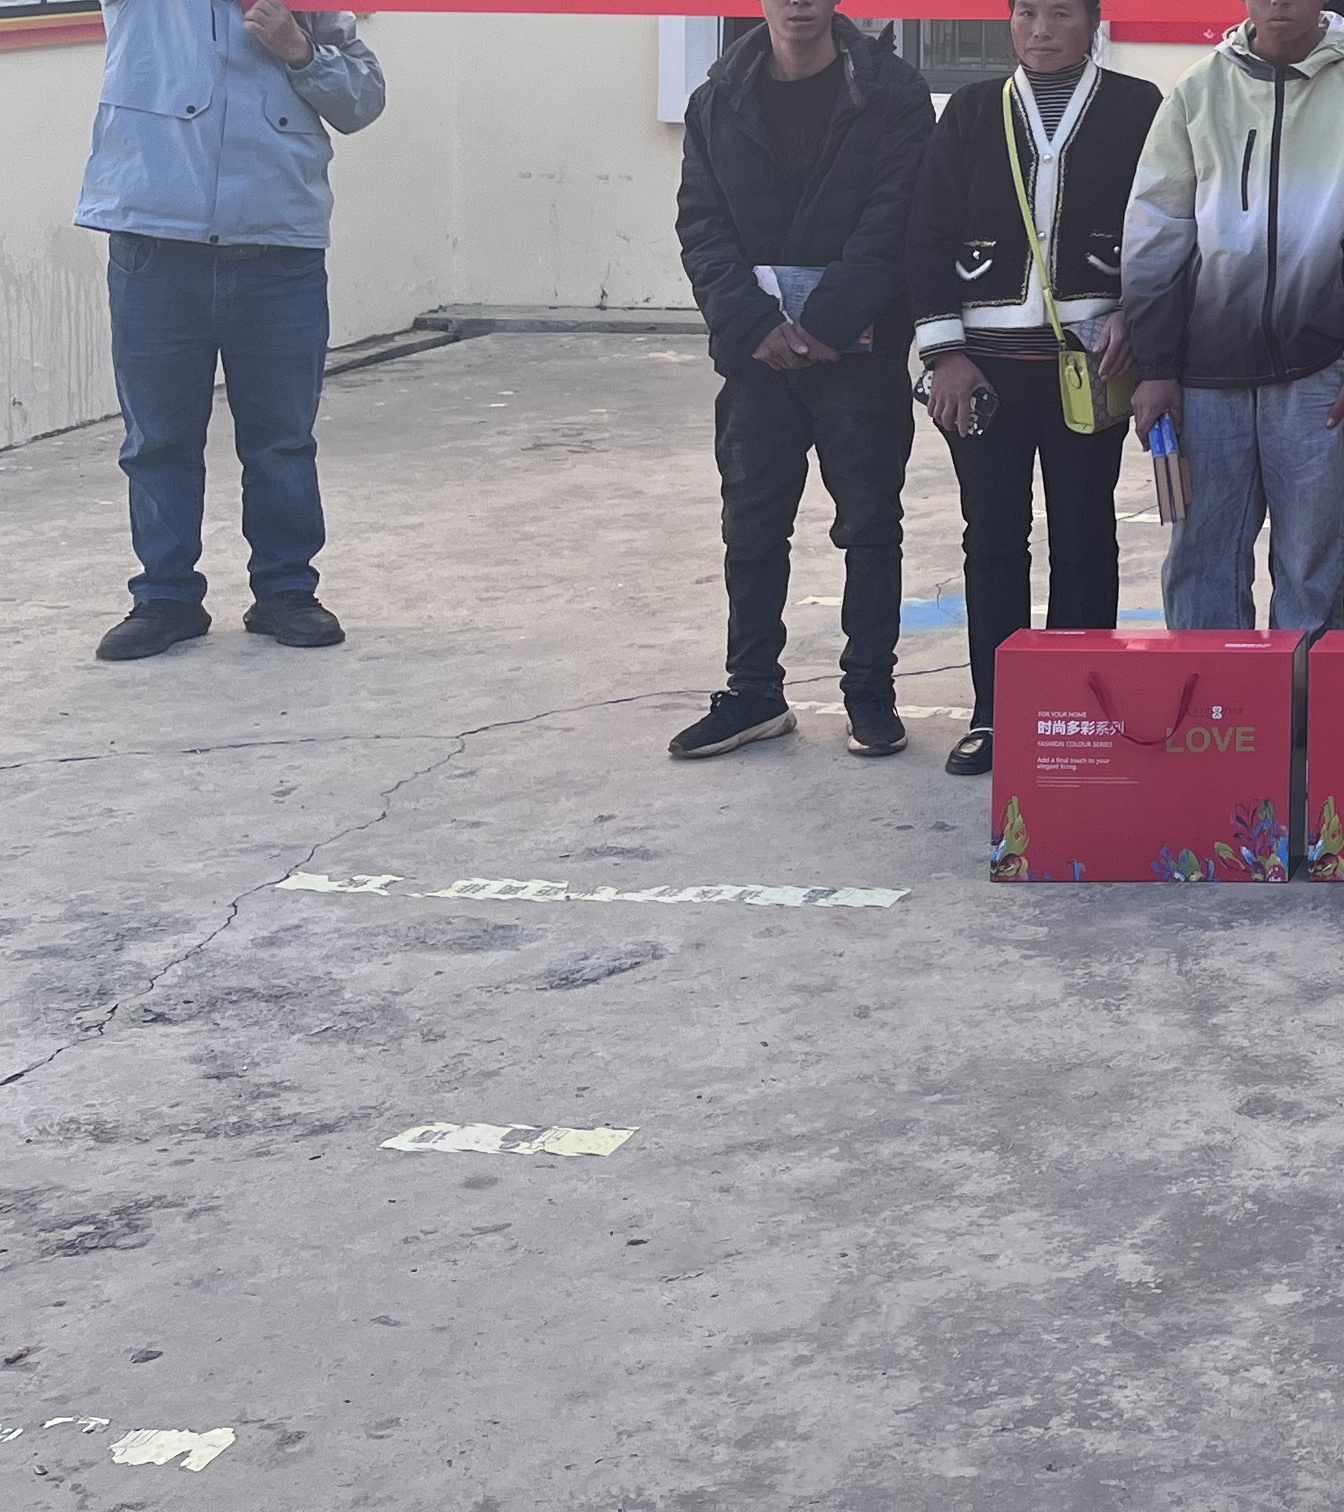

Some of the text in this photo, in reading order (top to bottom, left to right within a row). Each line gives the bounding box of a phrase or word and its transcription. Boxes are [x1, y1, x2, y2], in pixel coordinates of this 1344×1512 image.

[1037, 720, 1125, 735] 时尚多彩系列
[1166, 727, 1256, 752] LOVE
